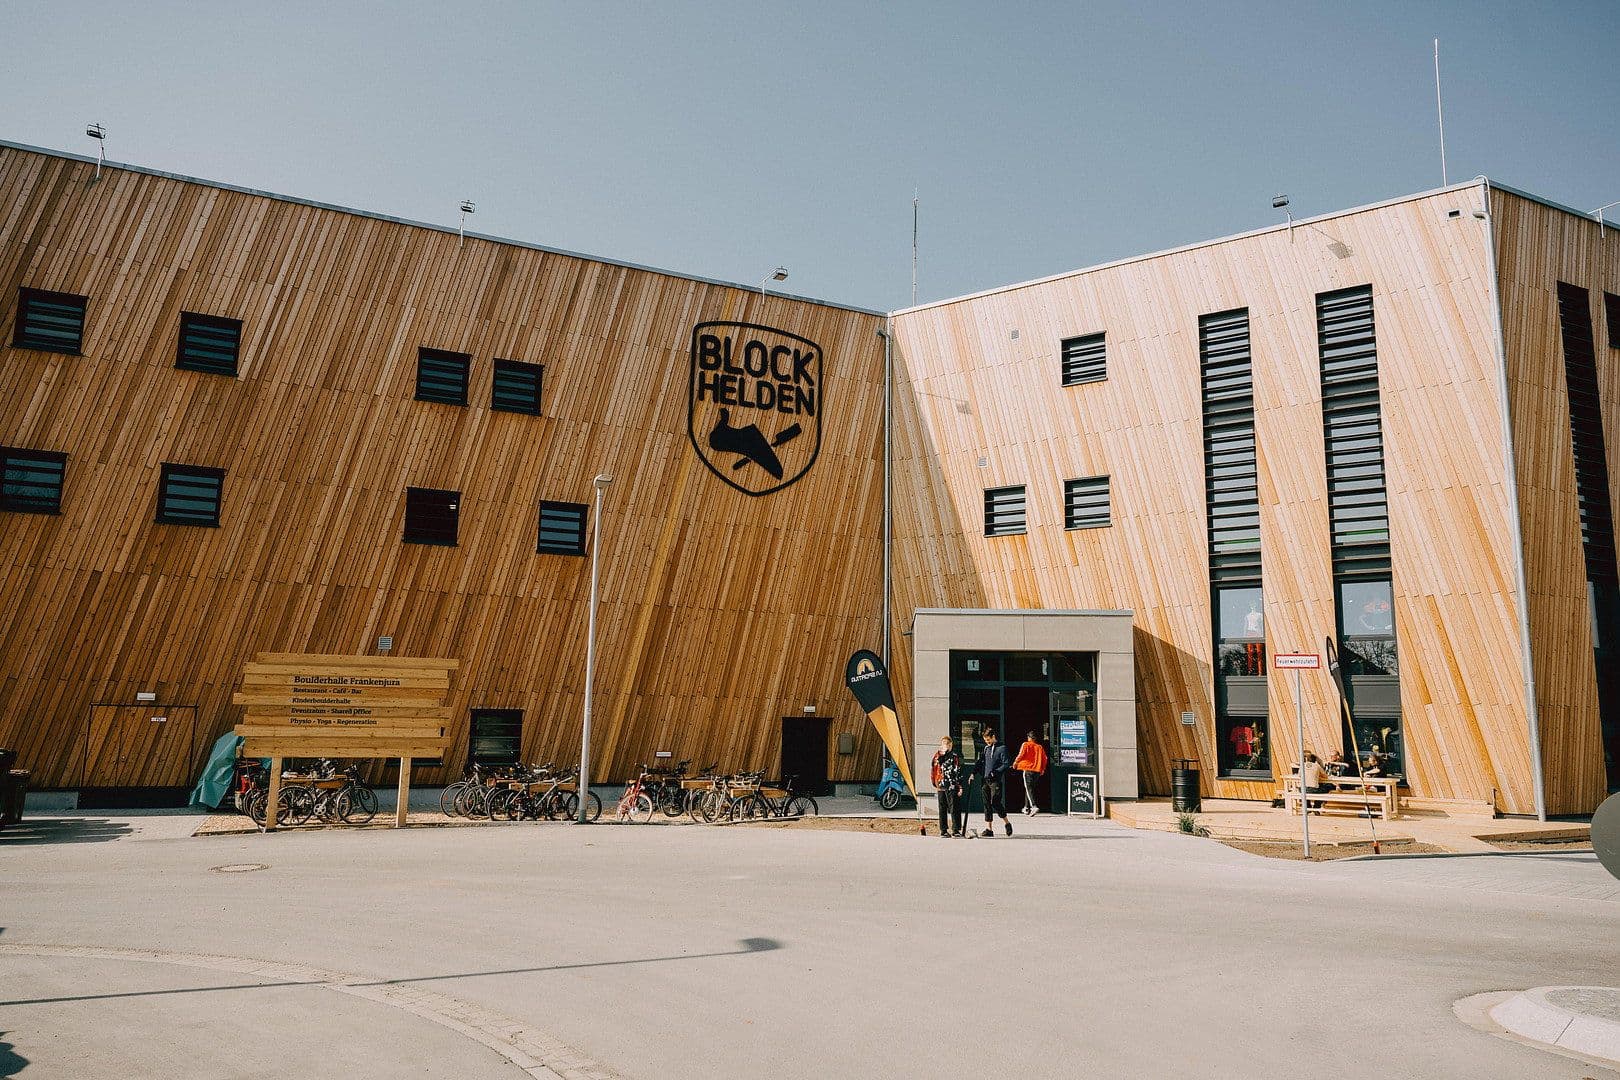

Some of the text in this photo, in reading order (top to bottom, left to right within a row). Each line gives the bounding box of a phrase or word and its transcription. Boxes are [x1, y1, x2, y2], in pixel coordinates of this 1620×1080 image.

[699, 334, 815, 386] BLOCK
[698, 371, 815, 417] HELDEN
[294, 675, 400, 687] Boulderhalle Frankenjura
[332, 687, 347, 695] Café
[292, 697, 351, 705] Kinderboulderhalle
[290, 717, 378, 726] Physio Yoga Regeneration
